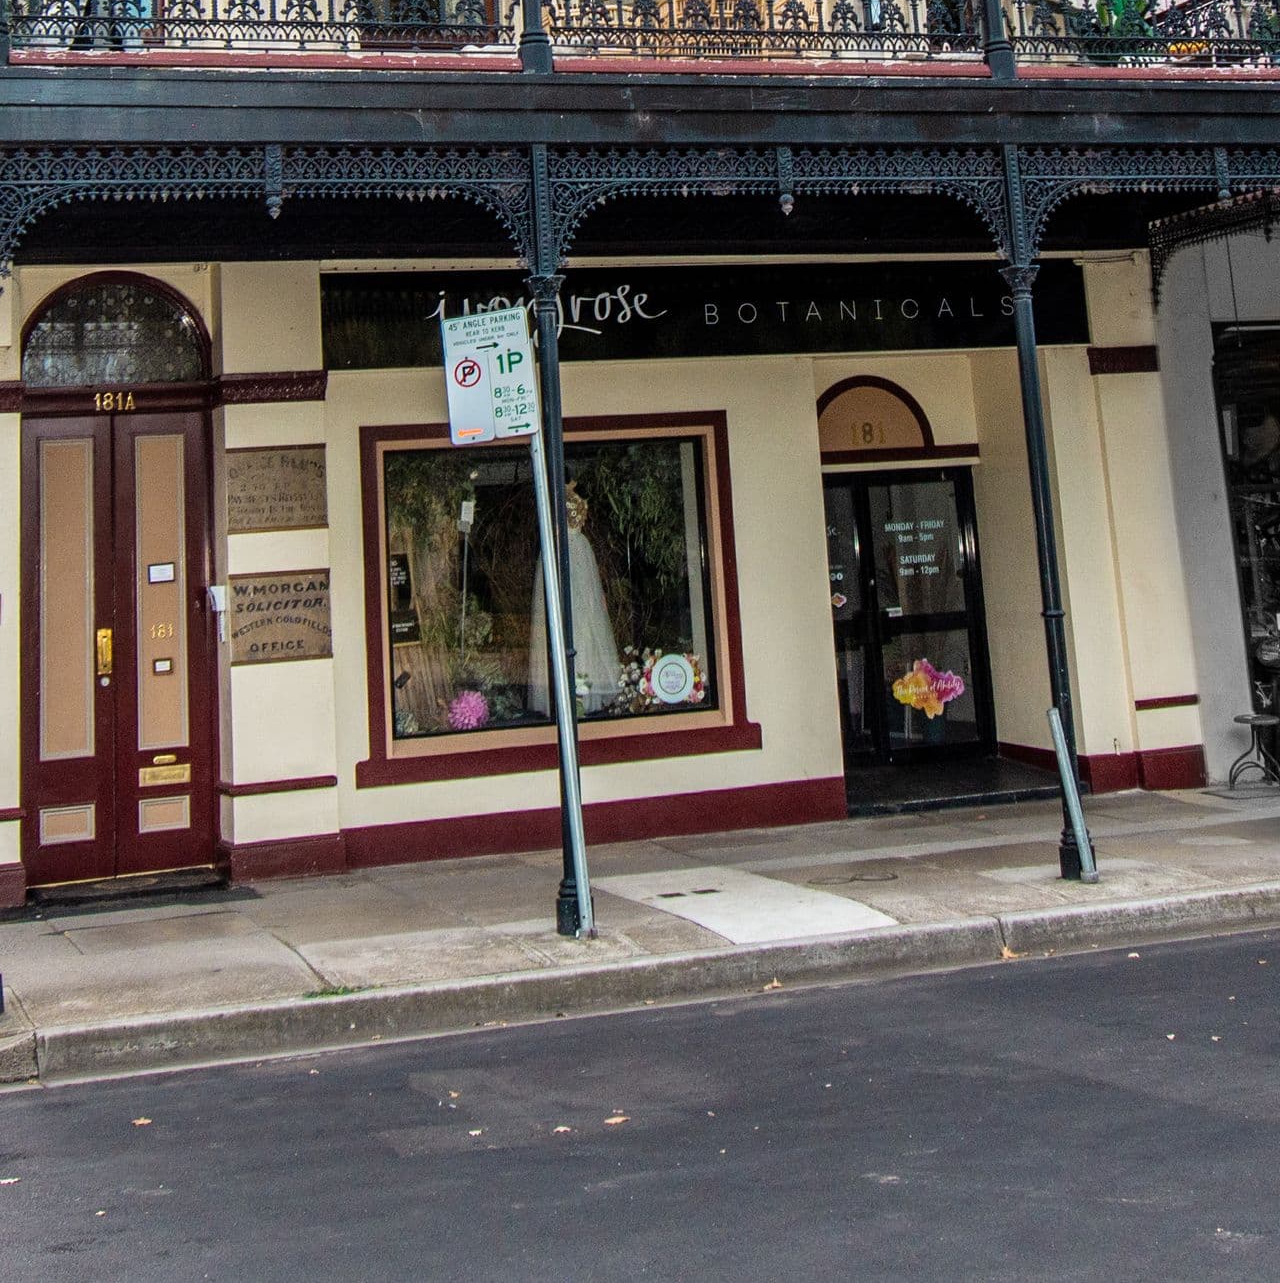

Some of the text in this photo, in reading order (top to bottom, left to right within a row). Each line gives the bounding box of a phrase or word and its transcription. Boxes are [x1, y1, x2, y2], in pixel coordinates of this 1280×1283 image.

[570, 284, 668, 324] rose
[704, 297, 1016, 325] BOTANICALS
[463, 317, 486, 330] ANGLE
[489, 312, 521, 325] PARKING
[496, 351, 523, 375] 1P
[93, 392, 136, 411] 181A
[884, 521, 914, 533] MONDAY
[920, 519, 945, 531] FRIDAY
[898, 534, 914, 543] 9am
[900, 554, 936, 565] SATURDAY
[899, 566, 915, 577] 9am
[920, 565, 940, 577] 12pm
[150, 623, 174, 638] 181
[231, 618, 273, 639] WESTERN
[250, 640, 304, 653] OFFICE
